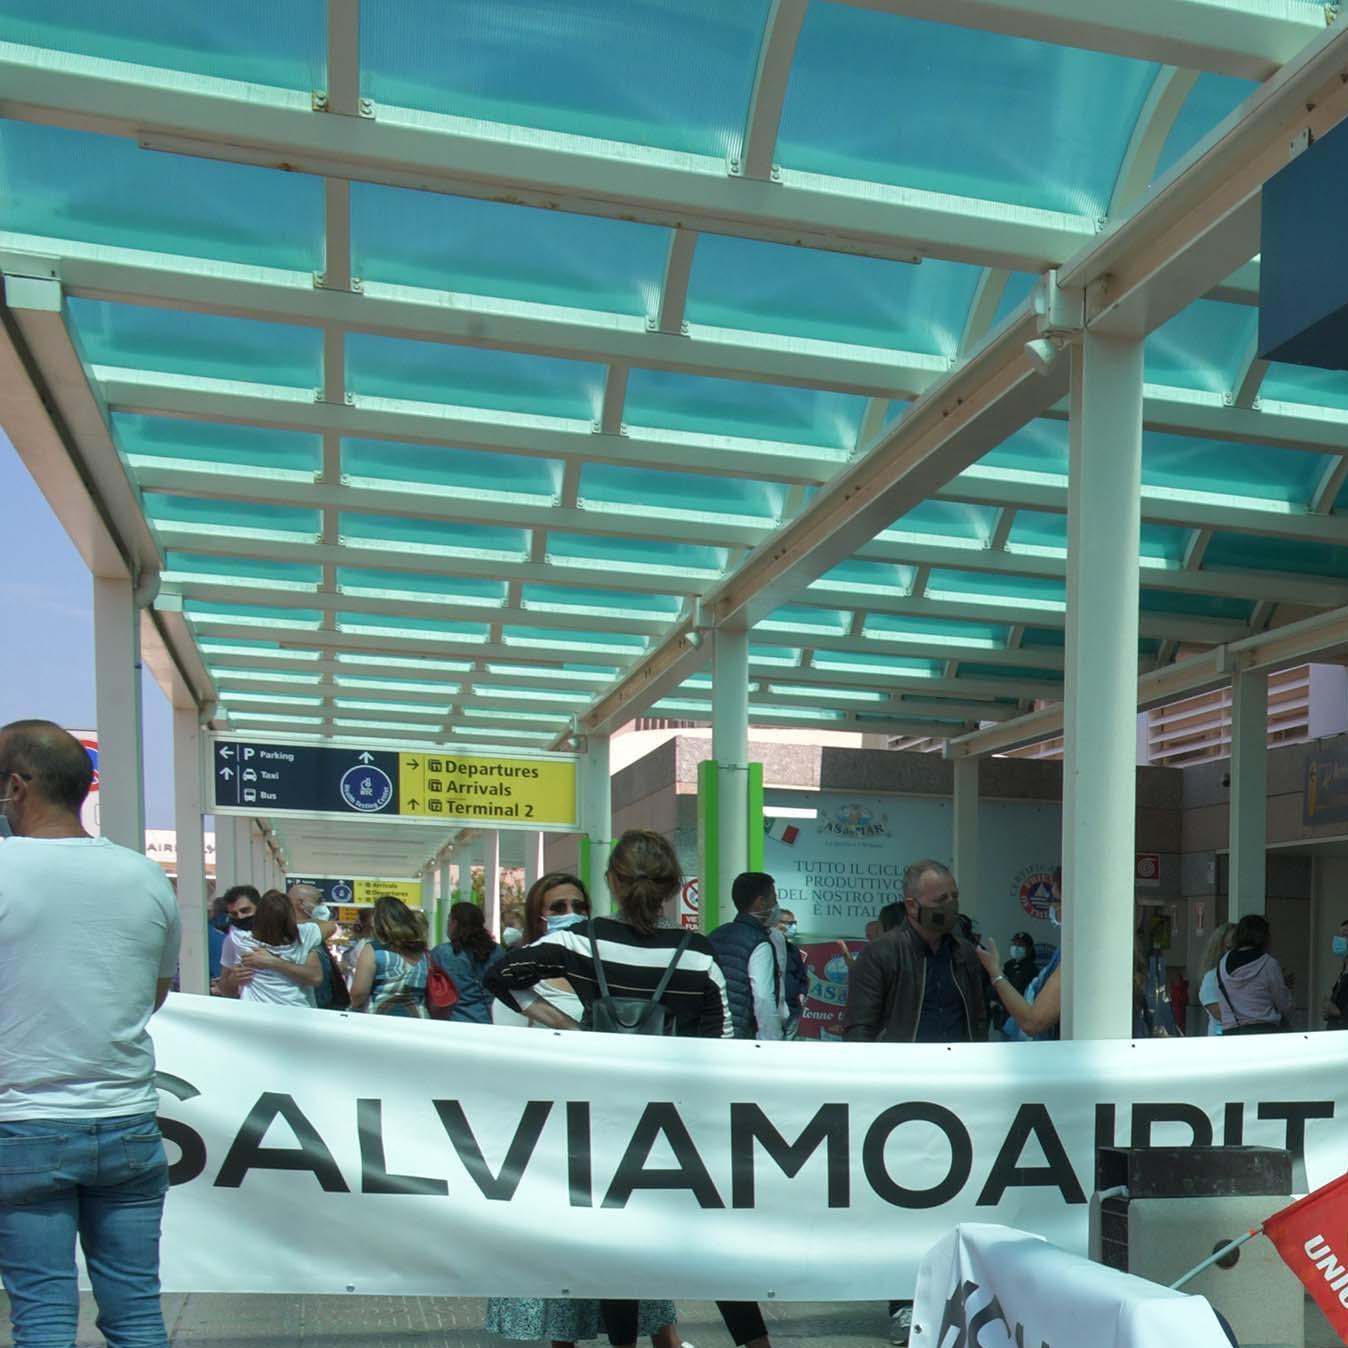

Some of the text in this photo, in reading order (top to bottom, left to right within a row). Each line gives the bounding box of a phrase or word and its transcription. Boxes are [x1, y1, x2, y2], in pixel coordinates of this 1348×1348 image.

[260, 750, 294, 762] Parking
[260, 771, 279, 780] Taxi
[445, 760, 539, 778] Departures
[446, 780, 512, 796] Arrivals
[260, 791, 277, 800] Bus
[447, 800, 519, 817] Terminal
[524, 804, 534, 817] 2
[793, 860, 846, 873] TUTTO
[850, 863, 865, 874] IL
[805, 875, 904, 890] PRODUTTIVO
[778, 888, 808, 900] DEL
[812, 890, 874, 904] NOSTRO
[827, 904, 842, 916] IN
